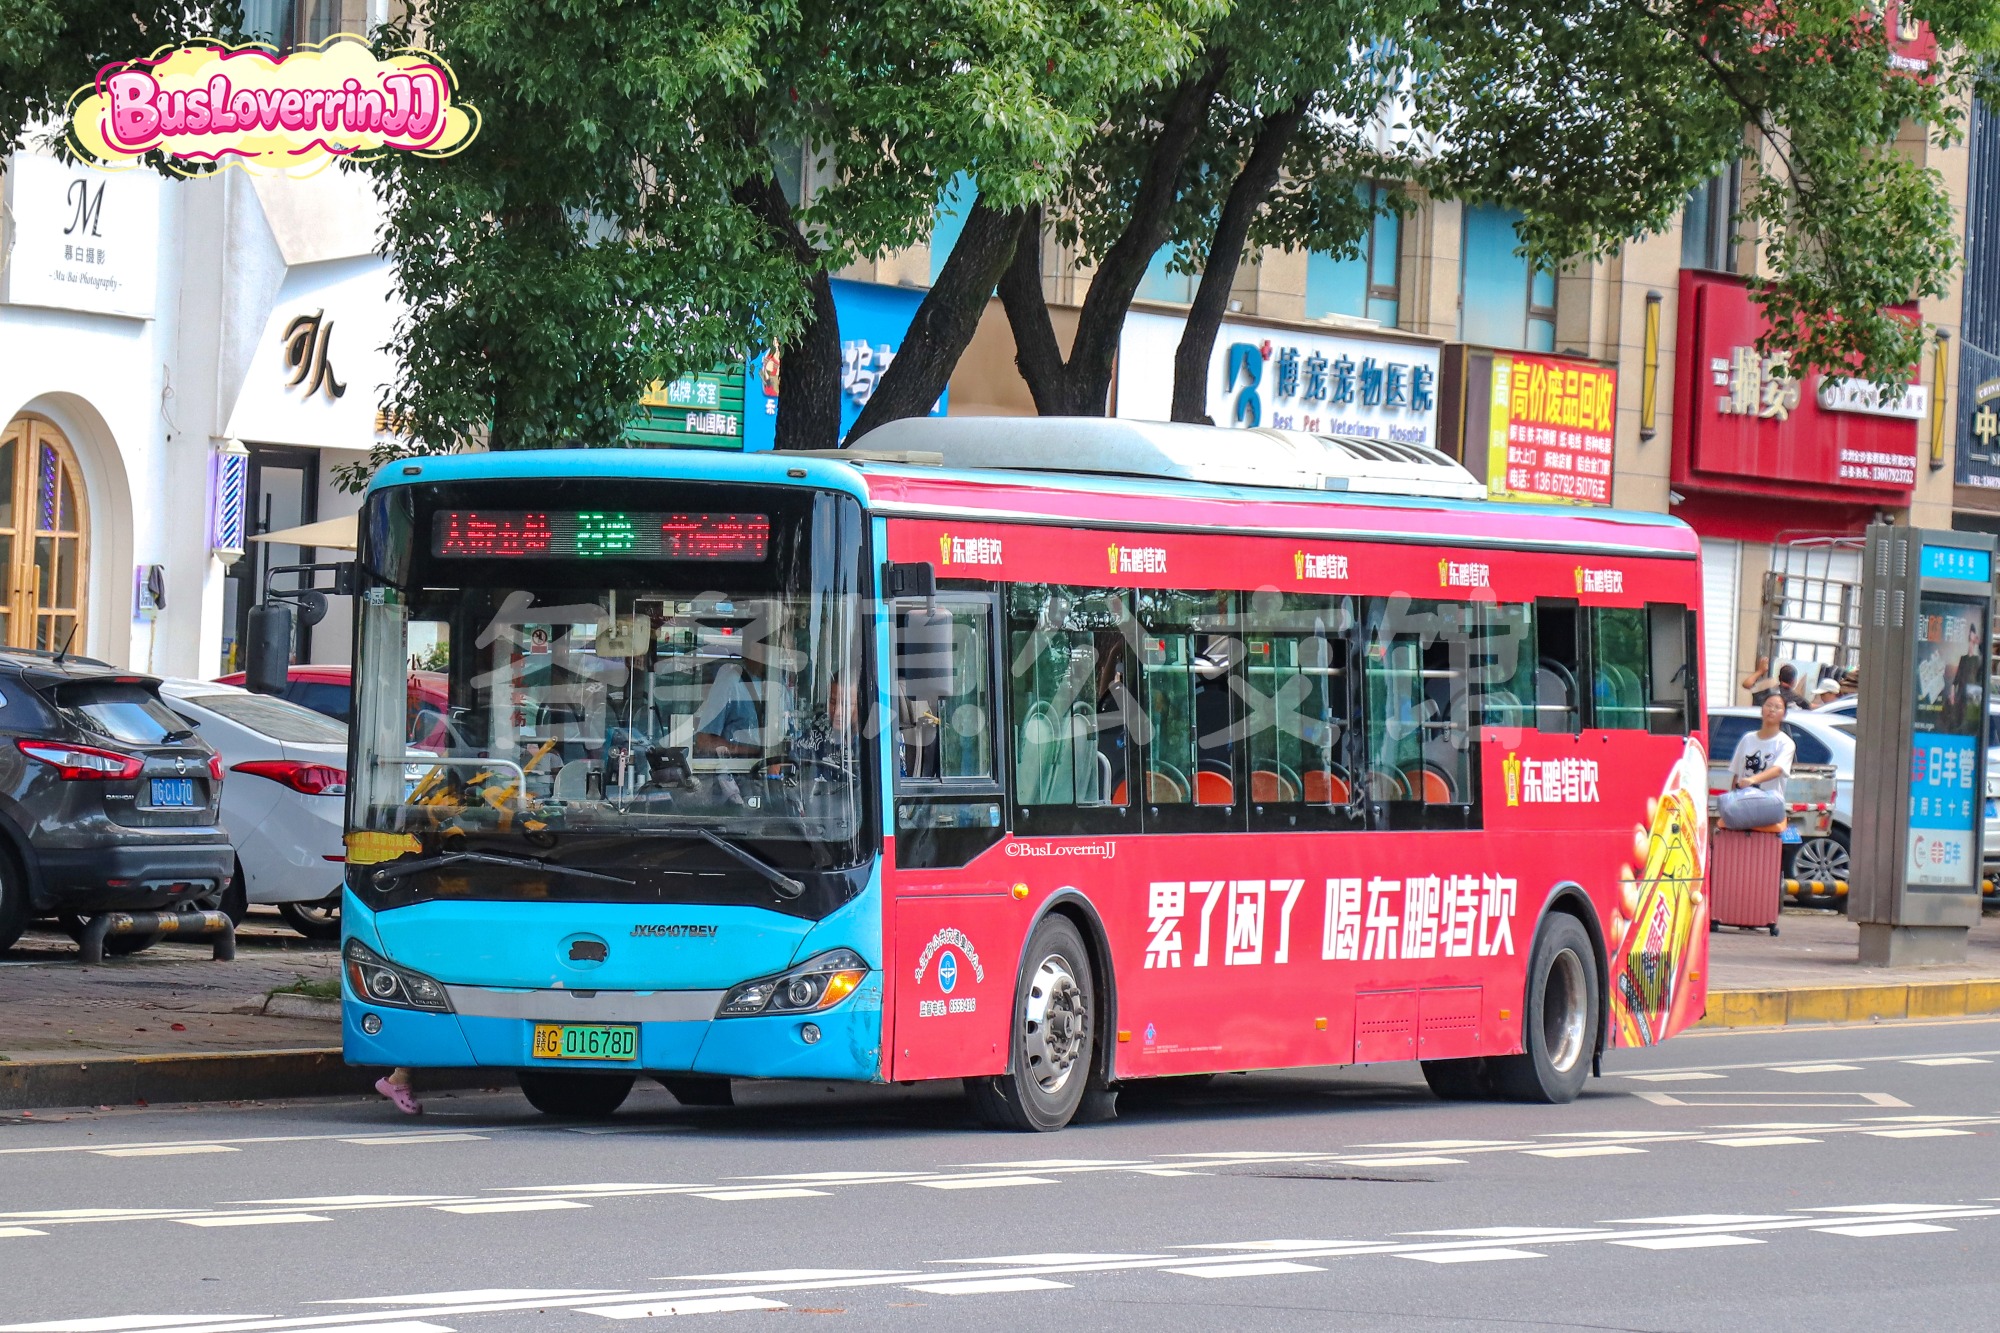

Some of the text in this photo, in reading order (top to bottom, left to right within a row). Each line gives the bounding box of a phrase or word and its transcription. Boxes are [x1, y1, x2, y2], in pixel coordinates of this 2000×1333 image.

[63, 178, 106, 238] M
[80, 272, 118, 292] Photography
[1277, 346, 1434, 411] 博宠宠物医院
[1511, 361, 1613, 432] 高价废品回收
[685, 412, 737, 436] 庐山国际店
[1273, 412, 1427, 444] Best Pet Veterinary Hospital
[952, 537, 1003, 565] 东鹏特饮
[1119, 546, 1167, 574] 东鹏特饮
[1305, 553, 1349, 580] 东鹏特饮
[1448, 561, 1490, 587] 东鹏特饮
[1584, 568, 1624, 594] 东鹏特饮
[1522, 757, 1600, 803] 东鹏特饮
[1929, 747, 1975, 788] 日丰管
[630, 924, 719, 938] JXK6107BEV
[1143, 872, 1518, 969] 累了困了 喝东鹏特饮
[914, 927, 985, 985] 九江市公共交通集团公司
